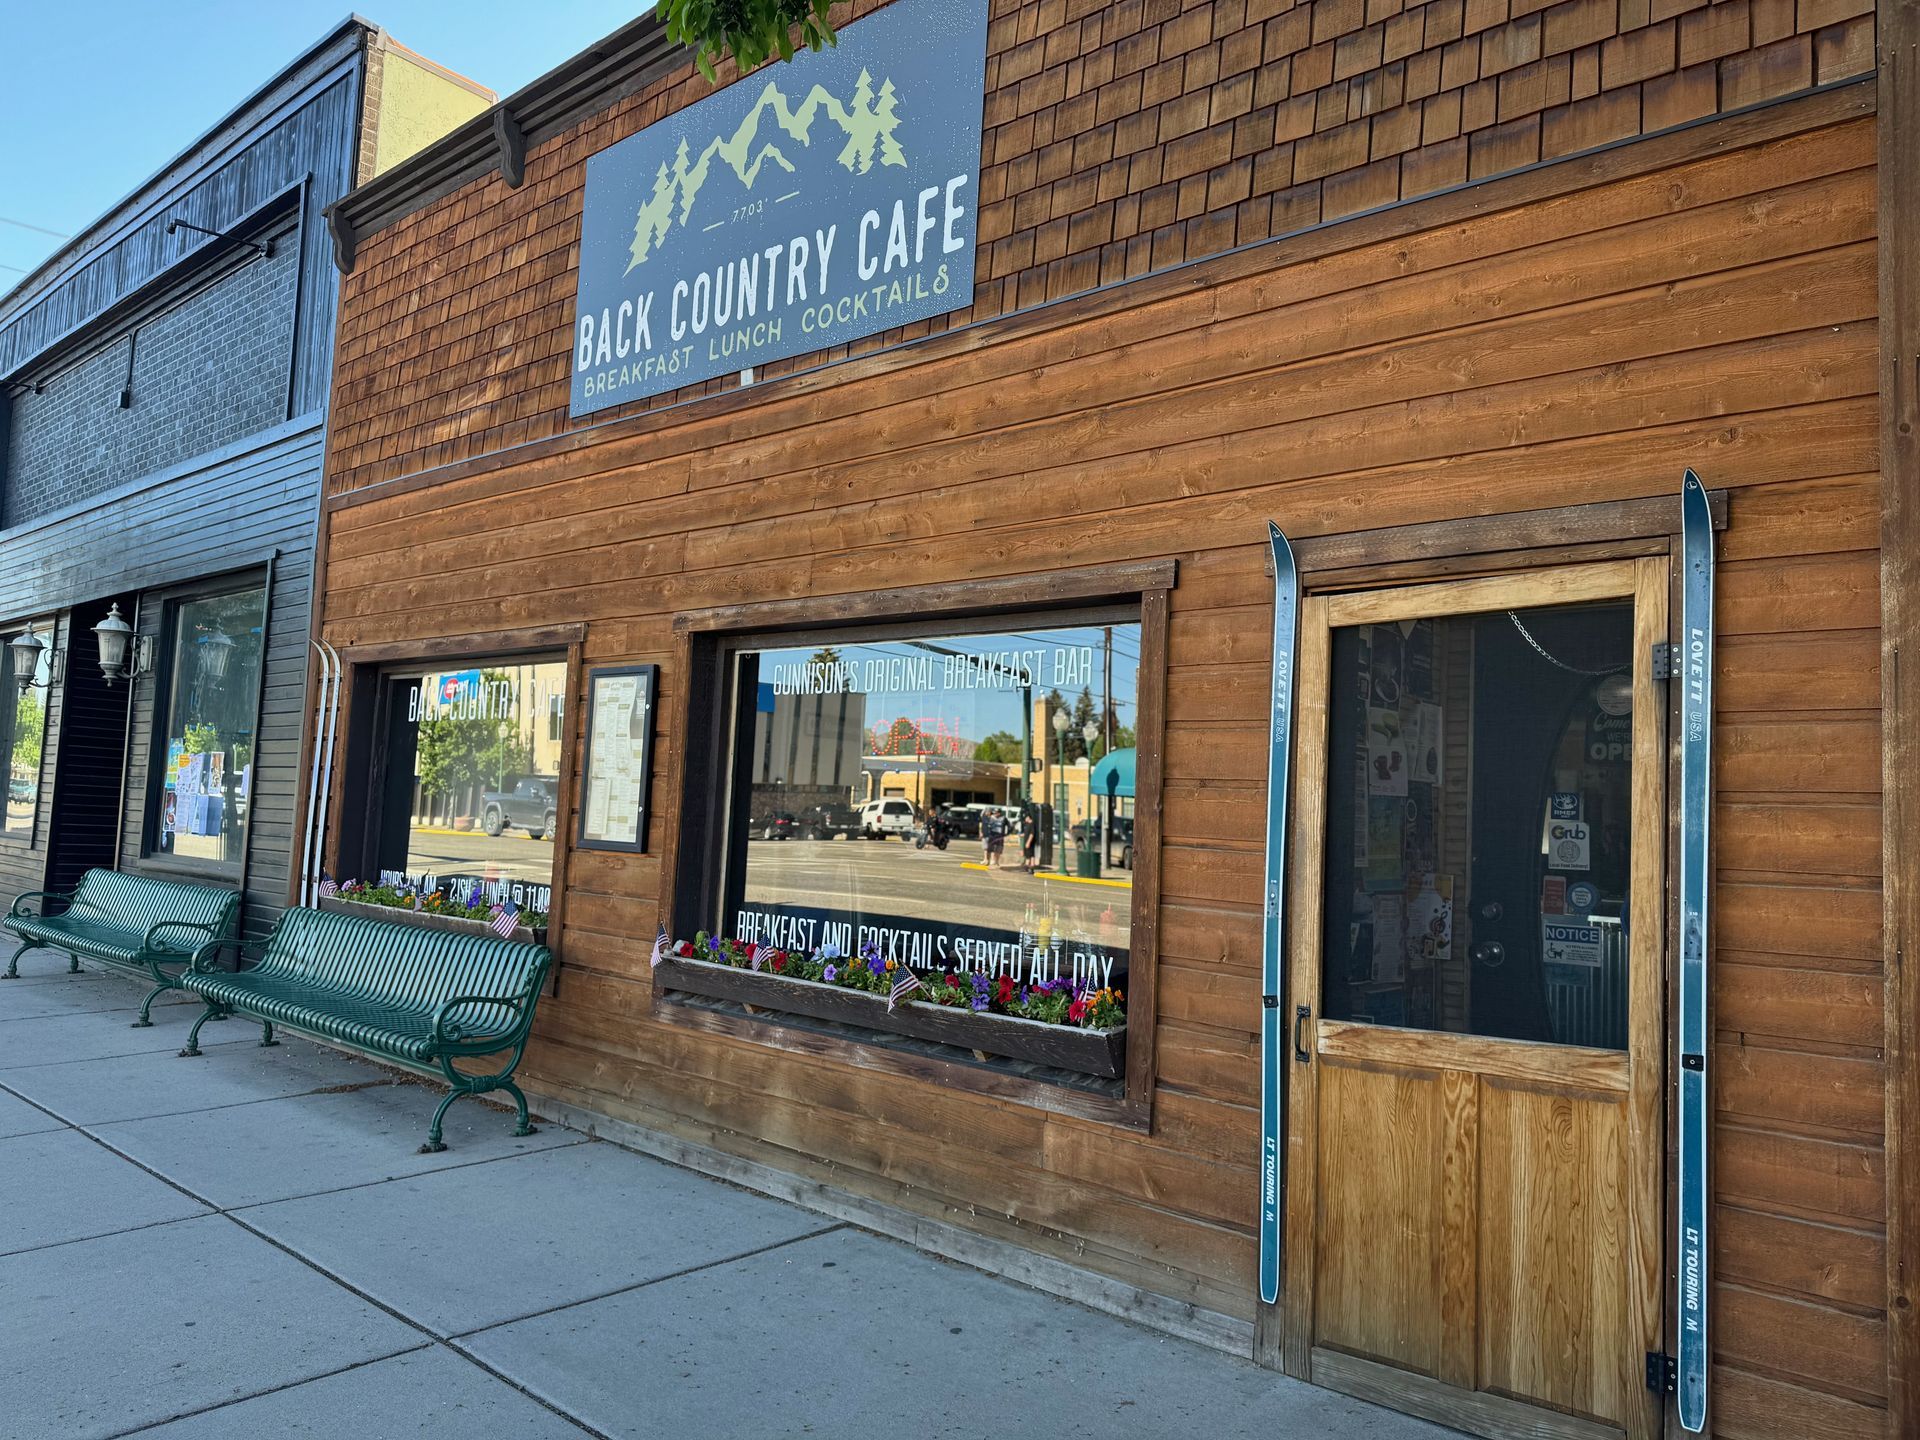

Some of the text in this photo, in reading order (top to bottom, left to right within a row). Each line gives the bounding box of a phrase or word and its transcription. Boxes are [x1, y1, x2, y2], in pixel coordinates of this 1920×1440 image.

[577, 174, 968, 372] BACK COUNTRY CAFE
[584, 263, 950, 398] BREAKFAST LUNCH COCKTAILS
[408, 683, 443, 722] BACK
[449, 680, 520, 720] COUNTRY
[773, 647, 1092, 695] GUNNISON'S ORIGINAL BREAKFAST BAR
[1275, 649, 1288, 743] LOVETT USA
[1689, 627, 1703, 742] LOVETT USA
[870, 716, 960, 755] OPEN
[1590, 742, 1632, 760] OPE
[1551, 824, 1586, 840] Grub
[424, 875, 437, 895] AM
[736, 910, 817, 952] BREAKFAST
[821, 921, 851, 957] AND
[857, 925, 948, 971] COCKTAILS
[953, 937, 1022, 983] SERVED
[1072, 952, 1114, 993] DAY
[1546, 927, 1599, 942] NOTICE
[1265, 1136, 1275, 1222] LT TOURING M
[1686, 1227, 1699, 1332] LT TOURING M
